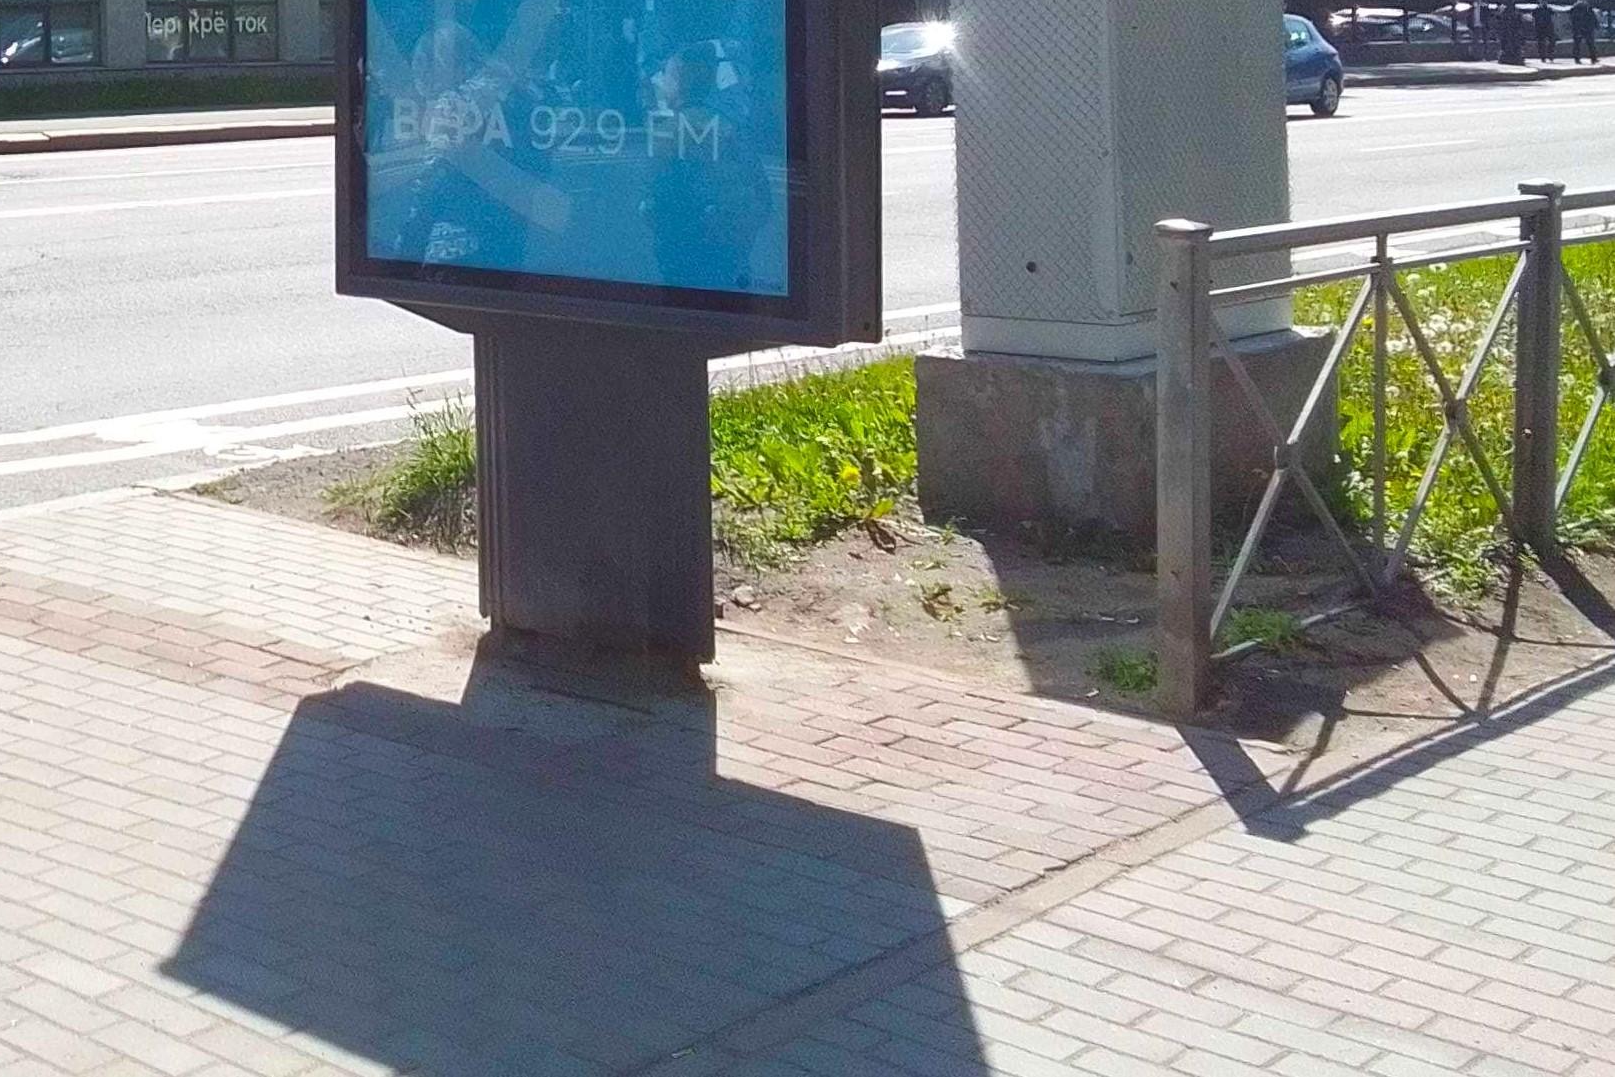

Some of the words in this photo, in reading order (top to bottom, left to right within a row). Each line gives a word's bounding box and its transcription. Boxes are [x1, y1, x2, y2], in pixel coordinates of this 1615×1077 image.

[145, 10, 267, 39] еркрёток
[393, 98, 513, 148] ВЕРА
[646, 109, 721, 162] FM
